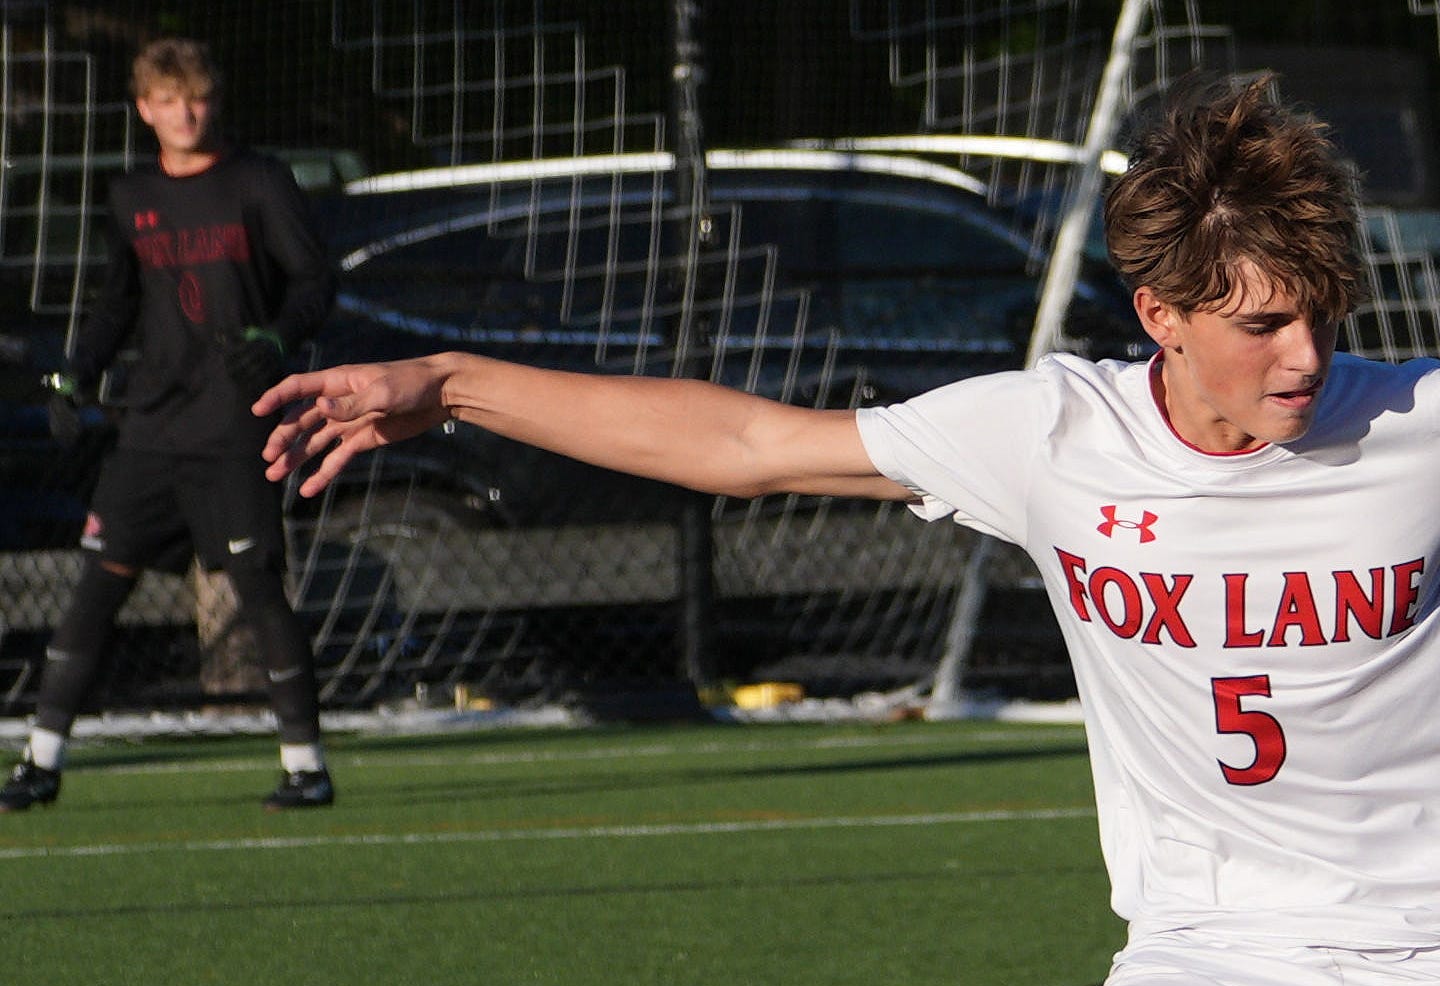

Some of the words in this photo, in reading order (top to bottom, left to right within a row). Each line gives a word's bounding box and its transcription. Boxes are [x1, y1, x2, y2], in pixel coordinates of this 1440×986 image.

[1054, 546, 1198, 648] FOX
[1222, 557, 1426, 648] LANE
[1211, 674, 1287, 786] 5
